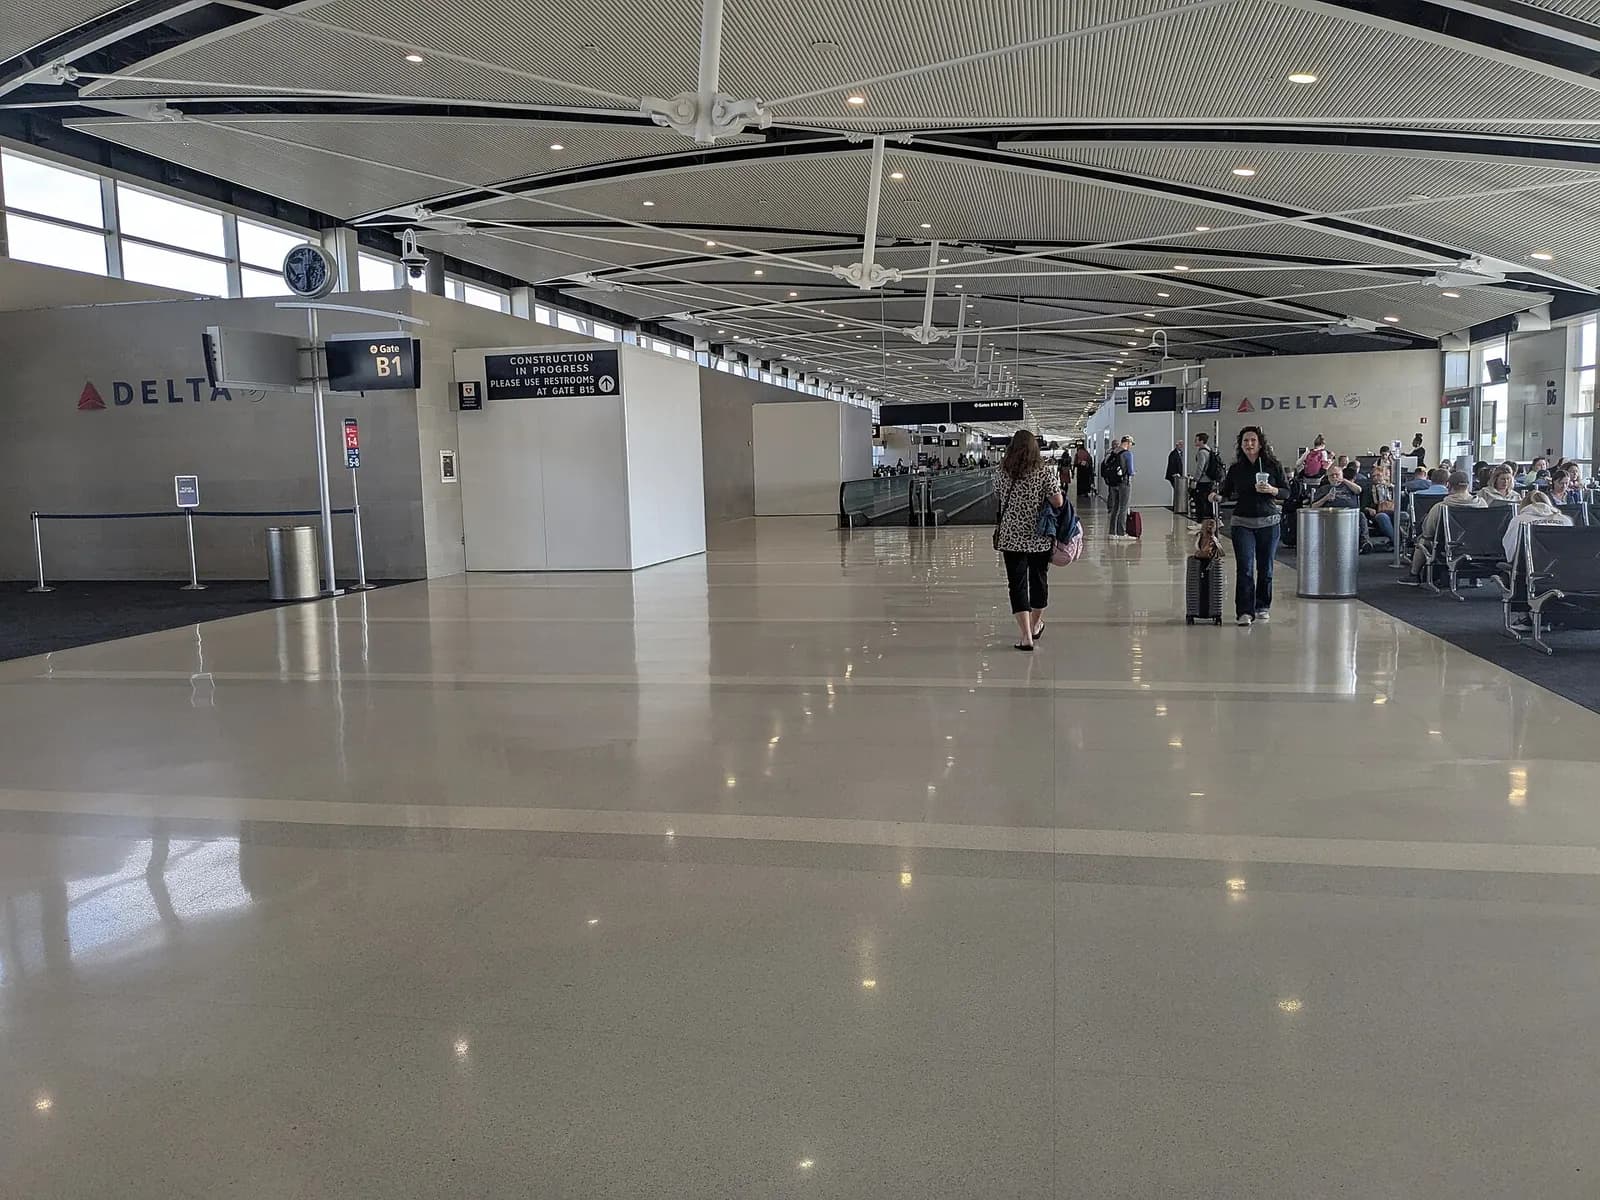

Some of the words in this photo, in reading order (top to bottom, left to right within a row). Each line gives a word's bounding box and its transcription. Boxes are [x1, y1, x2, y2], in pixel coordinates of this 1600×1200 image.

[380, 345, 400, 353] Gate
[509, 353, 594, 365] CONSTRUCTION
[376, 355, 402, 377] B1
[515, 367, 527, 375] IN
[533, 364, 590, 375] PROGRESS
[490, 378, 521, 388] PLEASE
[524, 377, 540, 386] USE
[544, 375, 595, 385] RESTROOMS
[113, 377, 233, 406] DELTA
[536, 387, 547, 396] AT
[552, 386, 575, 395] GATE
[579, 385, 595, 394] B15
[1134, 396, 1150, 407] B6
[1260, 394, 1338, 410] DELTA
